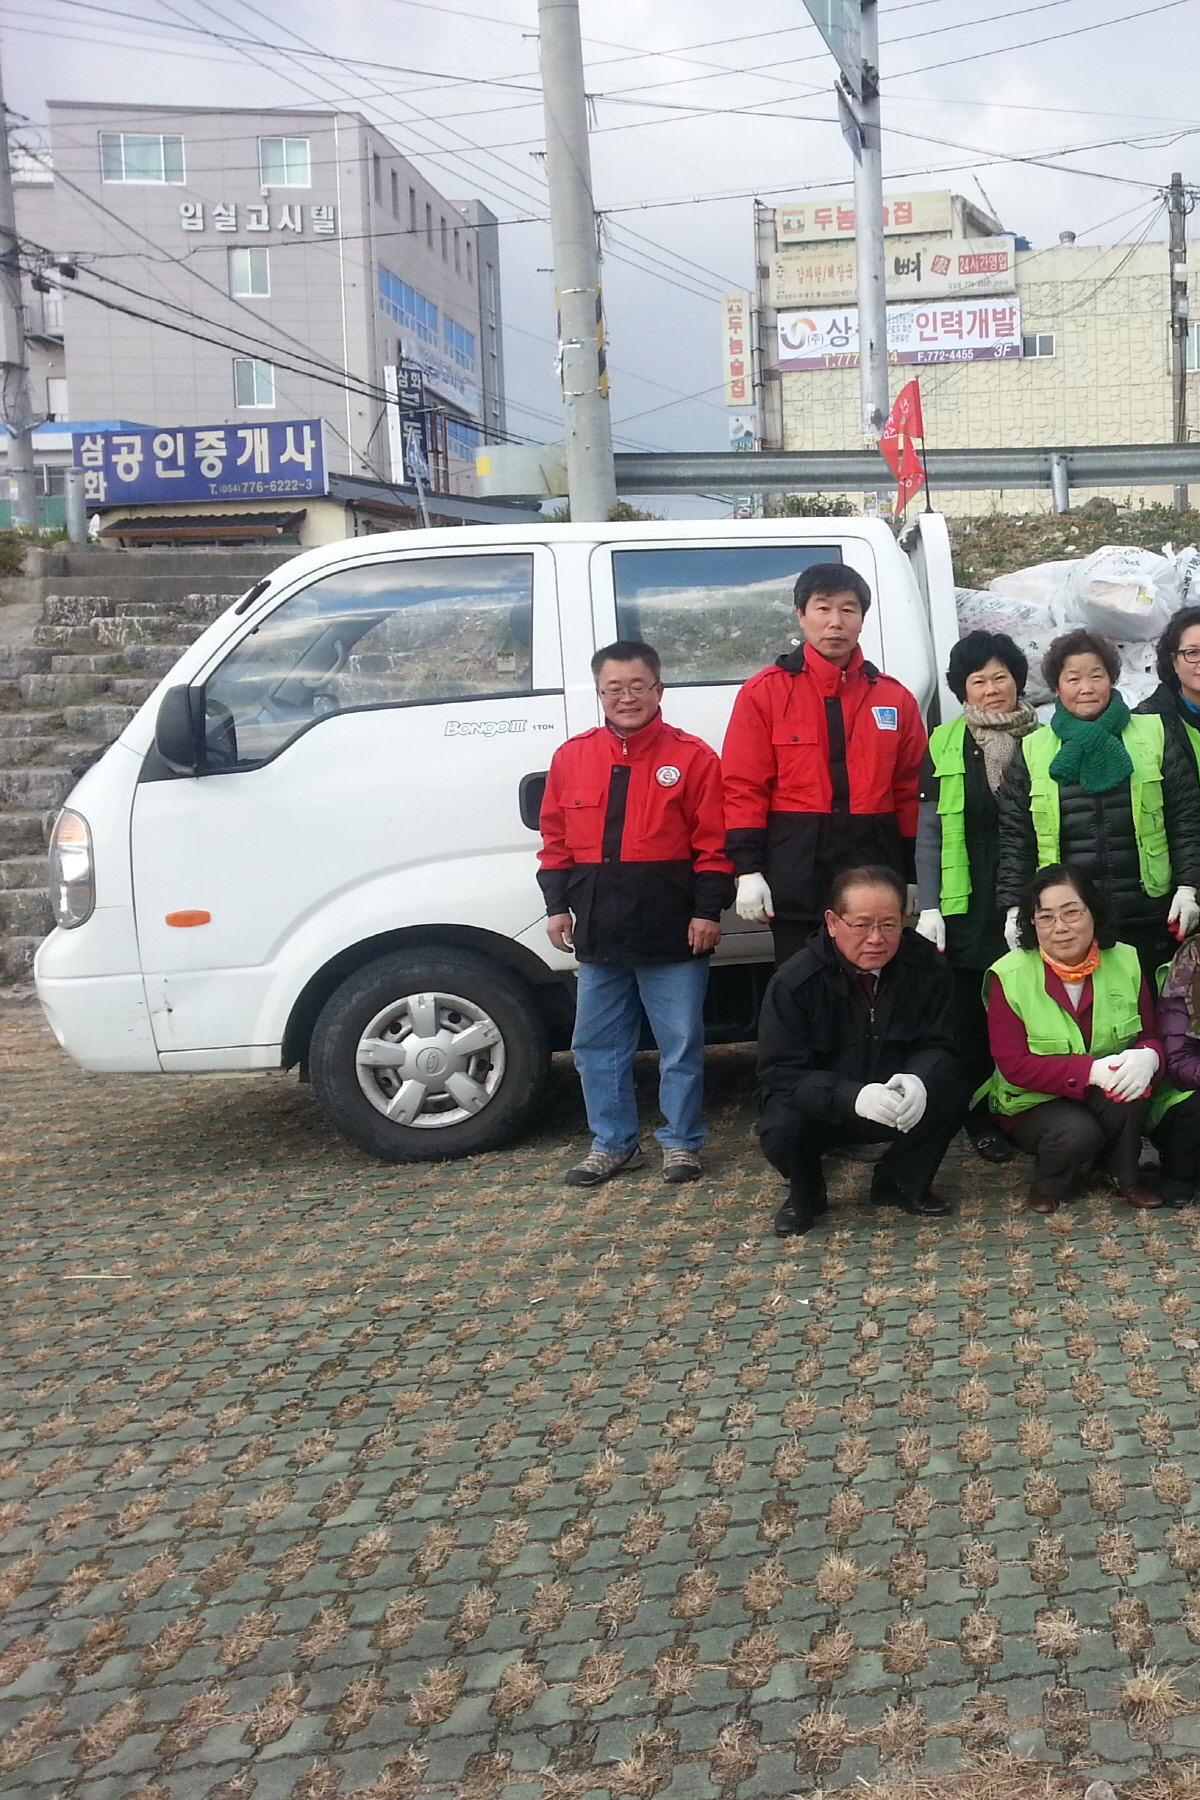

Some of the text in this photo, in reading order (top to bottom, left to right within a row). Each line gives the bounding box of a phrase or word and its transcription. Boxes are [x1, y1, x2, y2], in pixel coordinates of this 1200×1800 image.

[179, 202, 335, 234] 임실고시텔
[814, 201, 912, 231] 두놈집
[959, 254, 1008, 273] 24시간영업
[826, 316, 859, 347] 상
[916, 306, 1017, 342] 인력개발
[729, 316, 746, 399] 두놈술집
[918, 349, 974, 362] F.772-4455
[994, 342, 1013, 357] 3F
[80, 434, 107, 502] 삼화
[112, 425, 315, 482] 공인중개사
